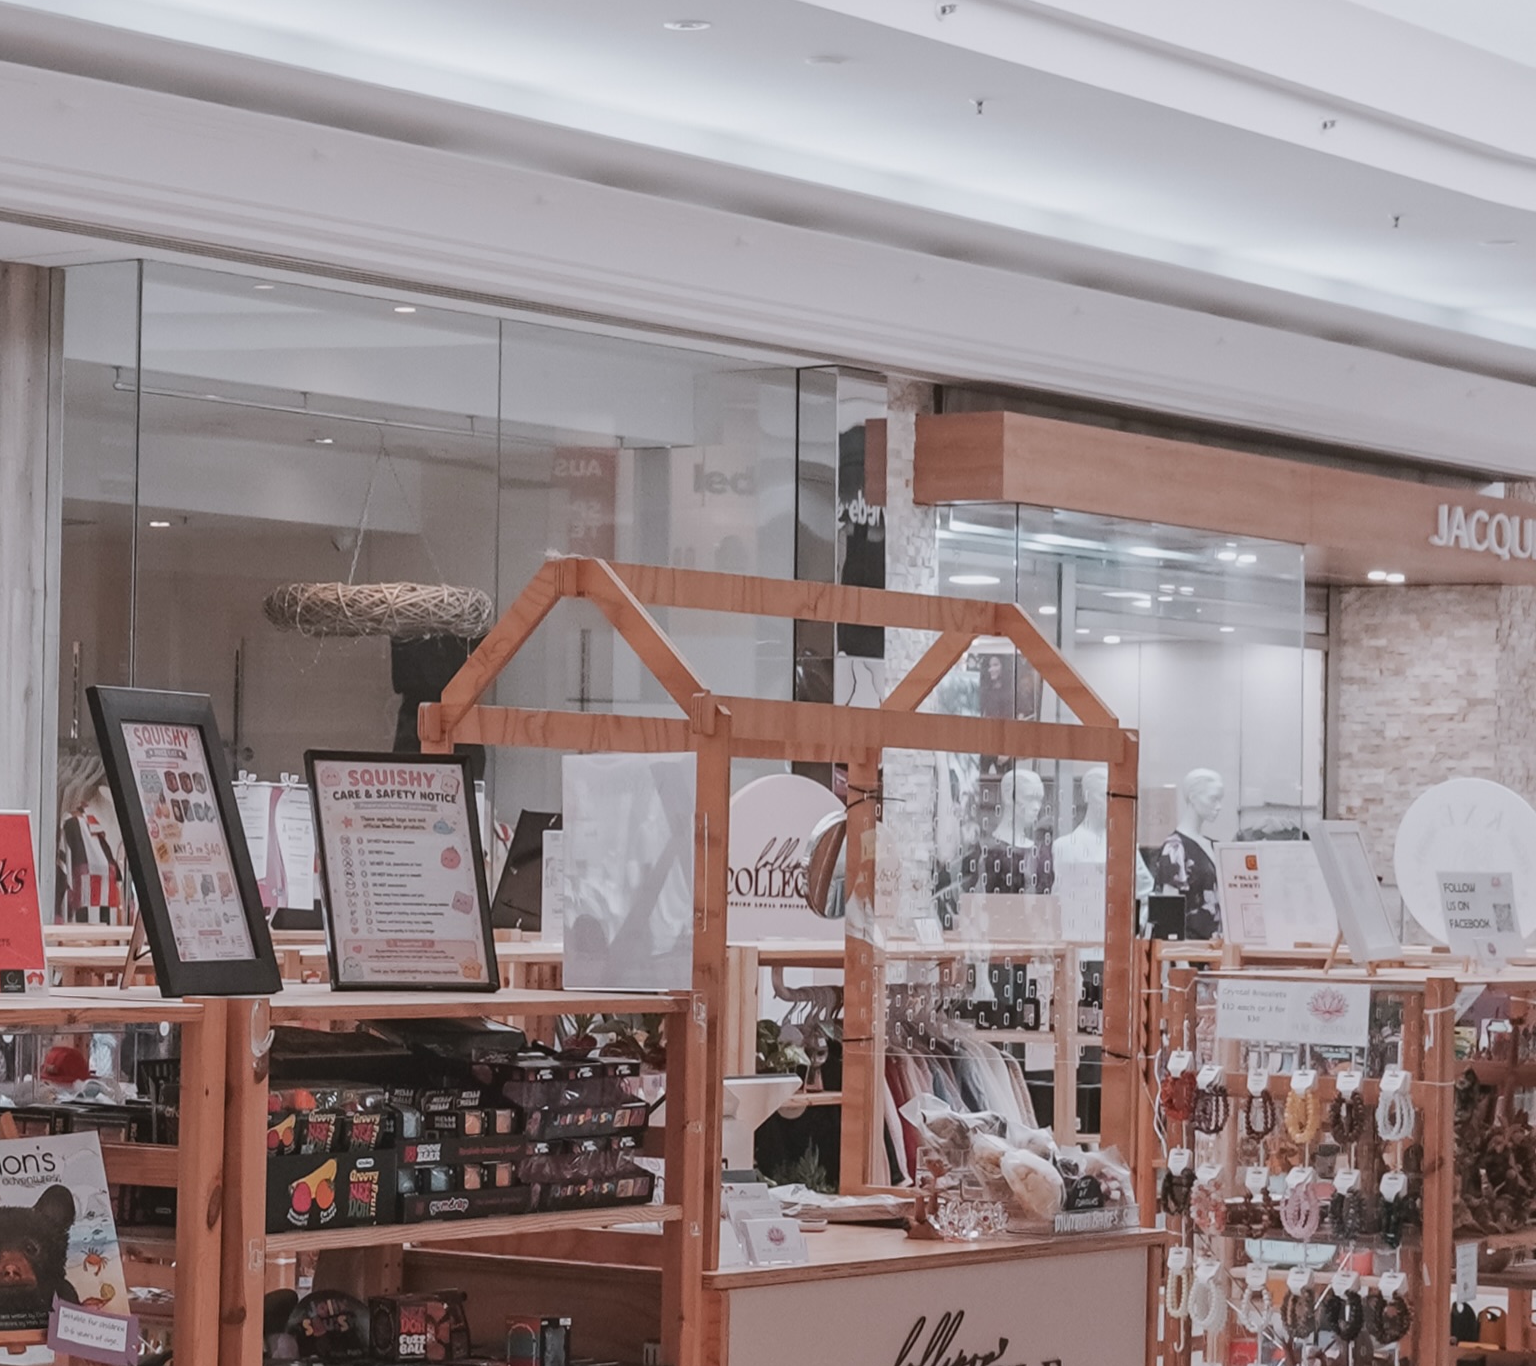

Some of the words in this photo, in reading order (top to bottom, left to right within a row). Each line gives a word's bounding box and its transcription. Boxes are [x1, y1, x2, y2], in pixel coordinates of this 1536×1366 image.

[1428, 504, 1536, 560] JACQU
[133, 726, 188, 748] SQUISHY
[348, 768, 435, 788] SQUISHY
[333, 789, 362, 801] CARE
[376, 789, 417, 801] SAFETY
[420, 791, 457, 804] NOTICE
[1443, 883, 1476, 893] FOLLOW
[1446, 901, 1456, 911] US
[1458, 901, 1470, 911] ON
[1449, 919, 1491, 929] FACEBOOK
[399, 1334, 426, 1345] FUZZ
[399, 1343, 426, 1354] BALL
